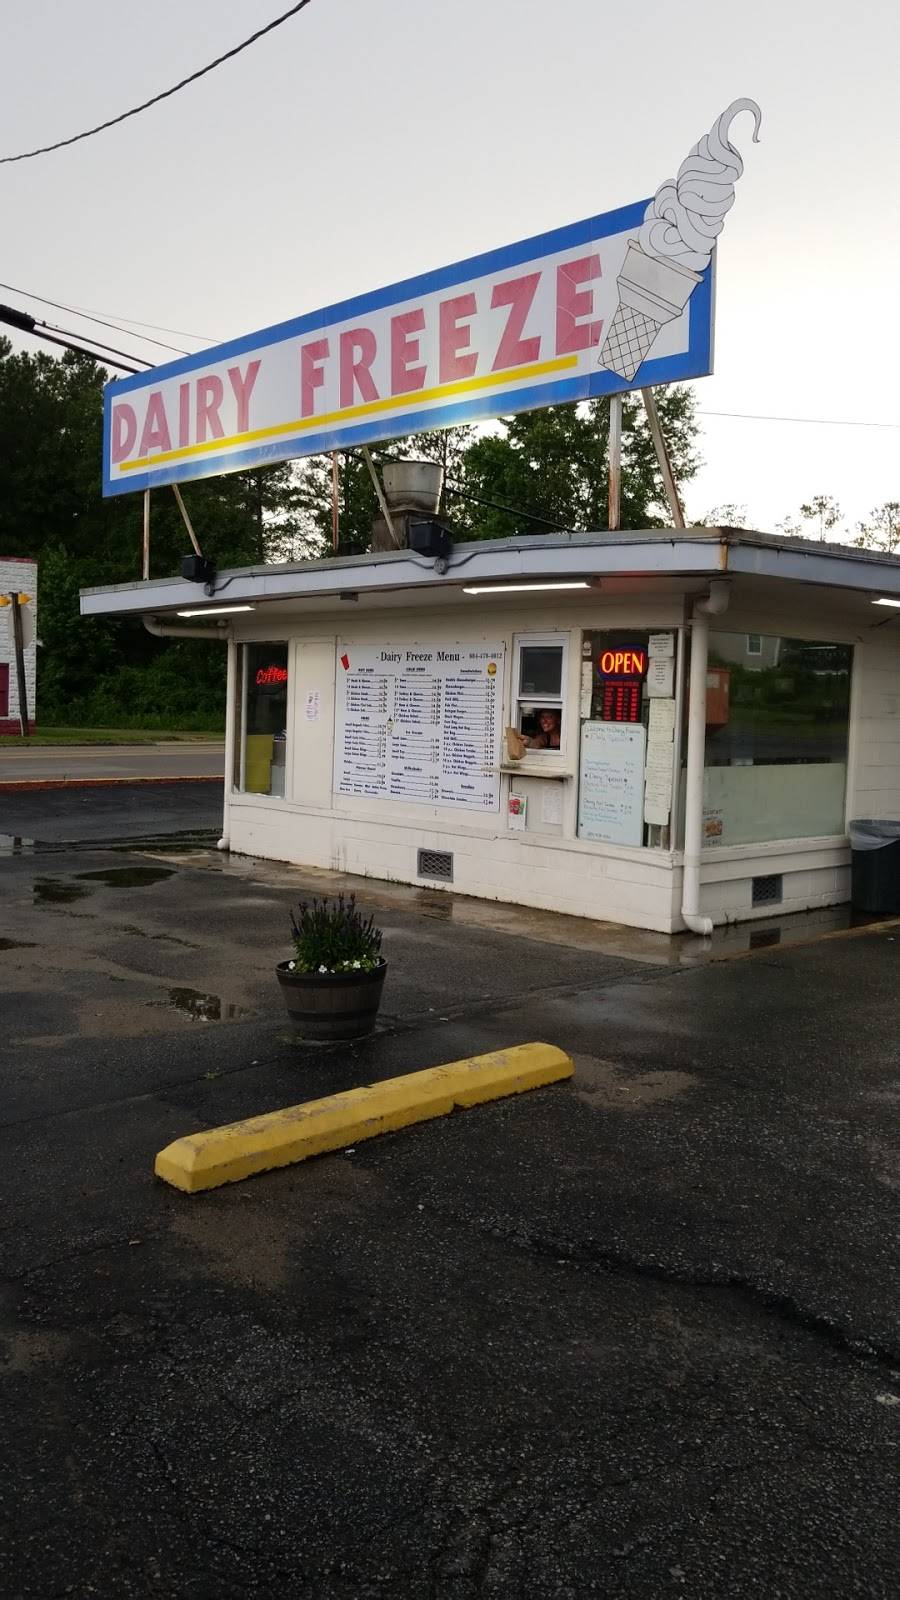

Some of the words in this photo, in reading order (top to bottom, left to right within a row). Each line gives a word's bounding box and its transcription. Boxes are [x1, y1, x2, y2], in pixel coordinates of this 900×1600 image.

[112, 360, 261, 464] DAIRY
[301, 254, 604, 418] FREEZE
[380, 651, 401, 663] Dairy
[406, 651, 432, 662] Freeze
[436, 651, 460, 662] Menu
[601, 652, 643, 674] OPEN
